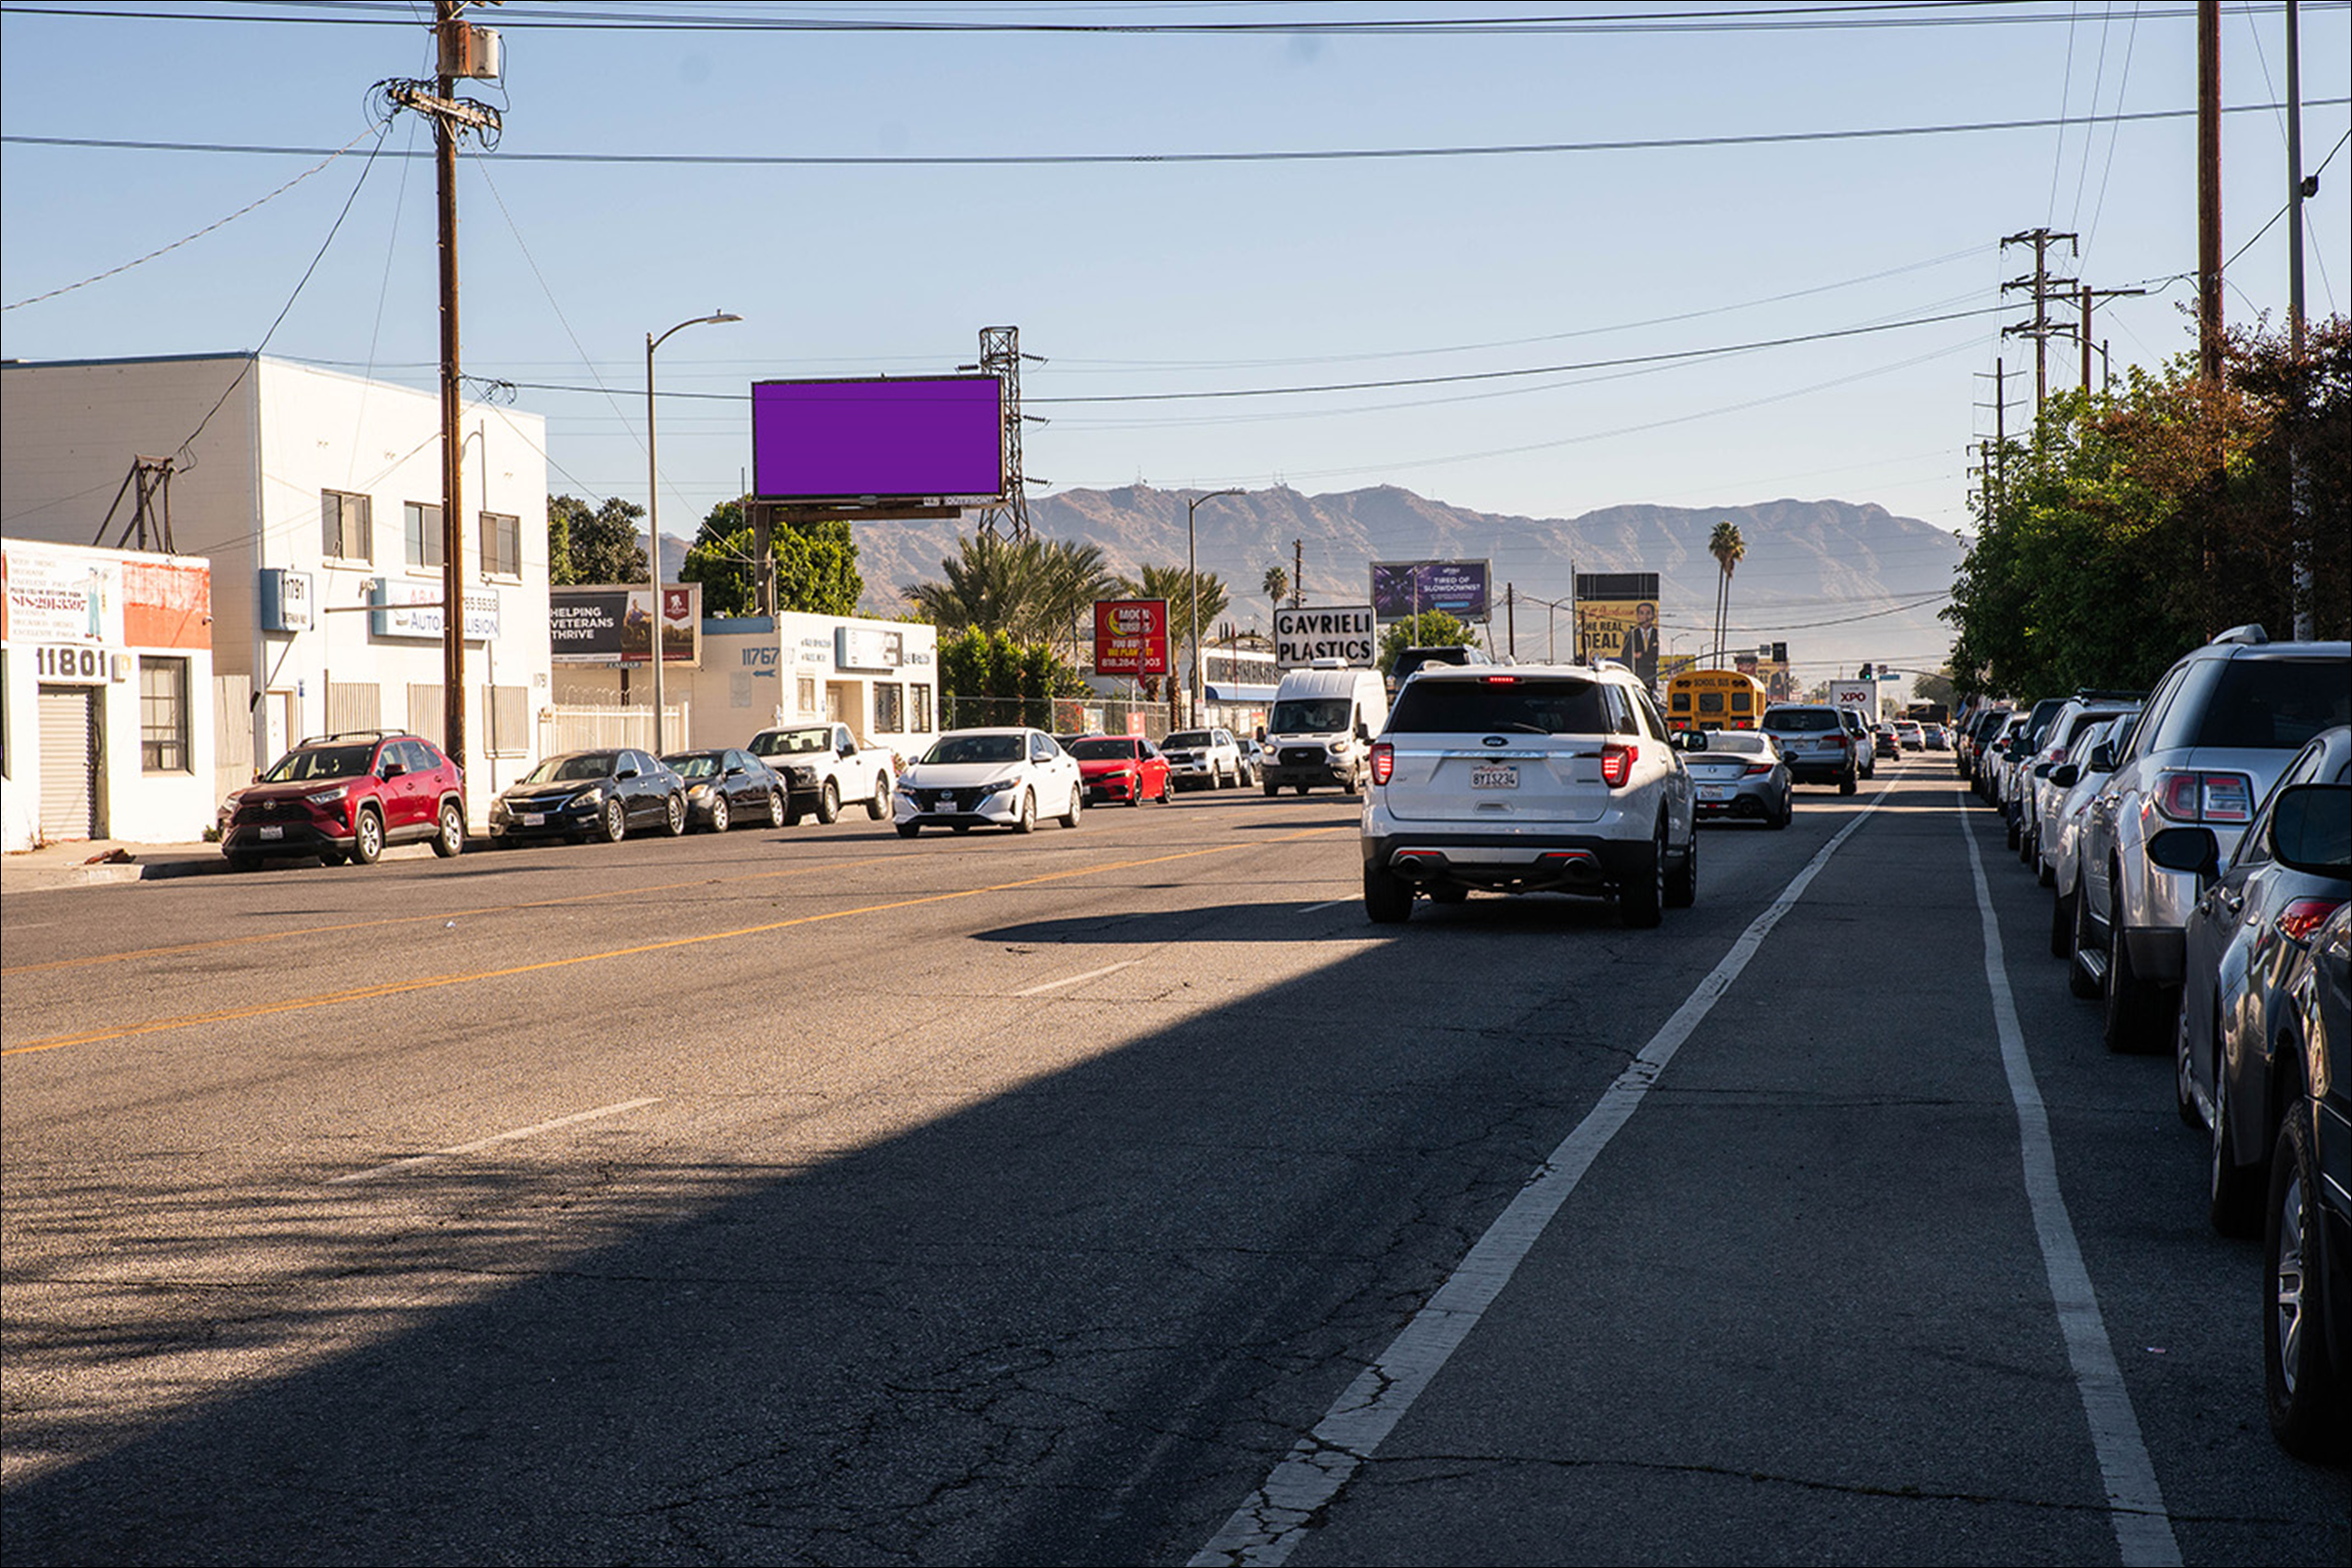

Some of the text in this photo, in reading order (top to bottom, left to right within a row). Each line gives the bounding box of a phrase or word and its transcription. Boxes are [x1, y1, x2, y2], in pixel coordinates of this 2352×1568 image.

[551, 607, 602, 617] HELPING
[410, 612, 441, 630] AUTO
[551, 617, 614, 628] VETERANS
[1279, 613, 1370, 635] GAVRIELI
[1600, 621, 1623, 631] REAL
[552, 629, 595, 639] THRIVE
[742, 647, 780, 665] 11767
[1120, 648, 1140, 657] PLAN
[1279, 640, 1370, 662] PLASTICS
[36, 648, 106, 677] 11801
[1693, 677, 1729, 687] SCHOOL BUS
[1840, 691, 1866, 703] XPO
